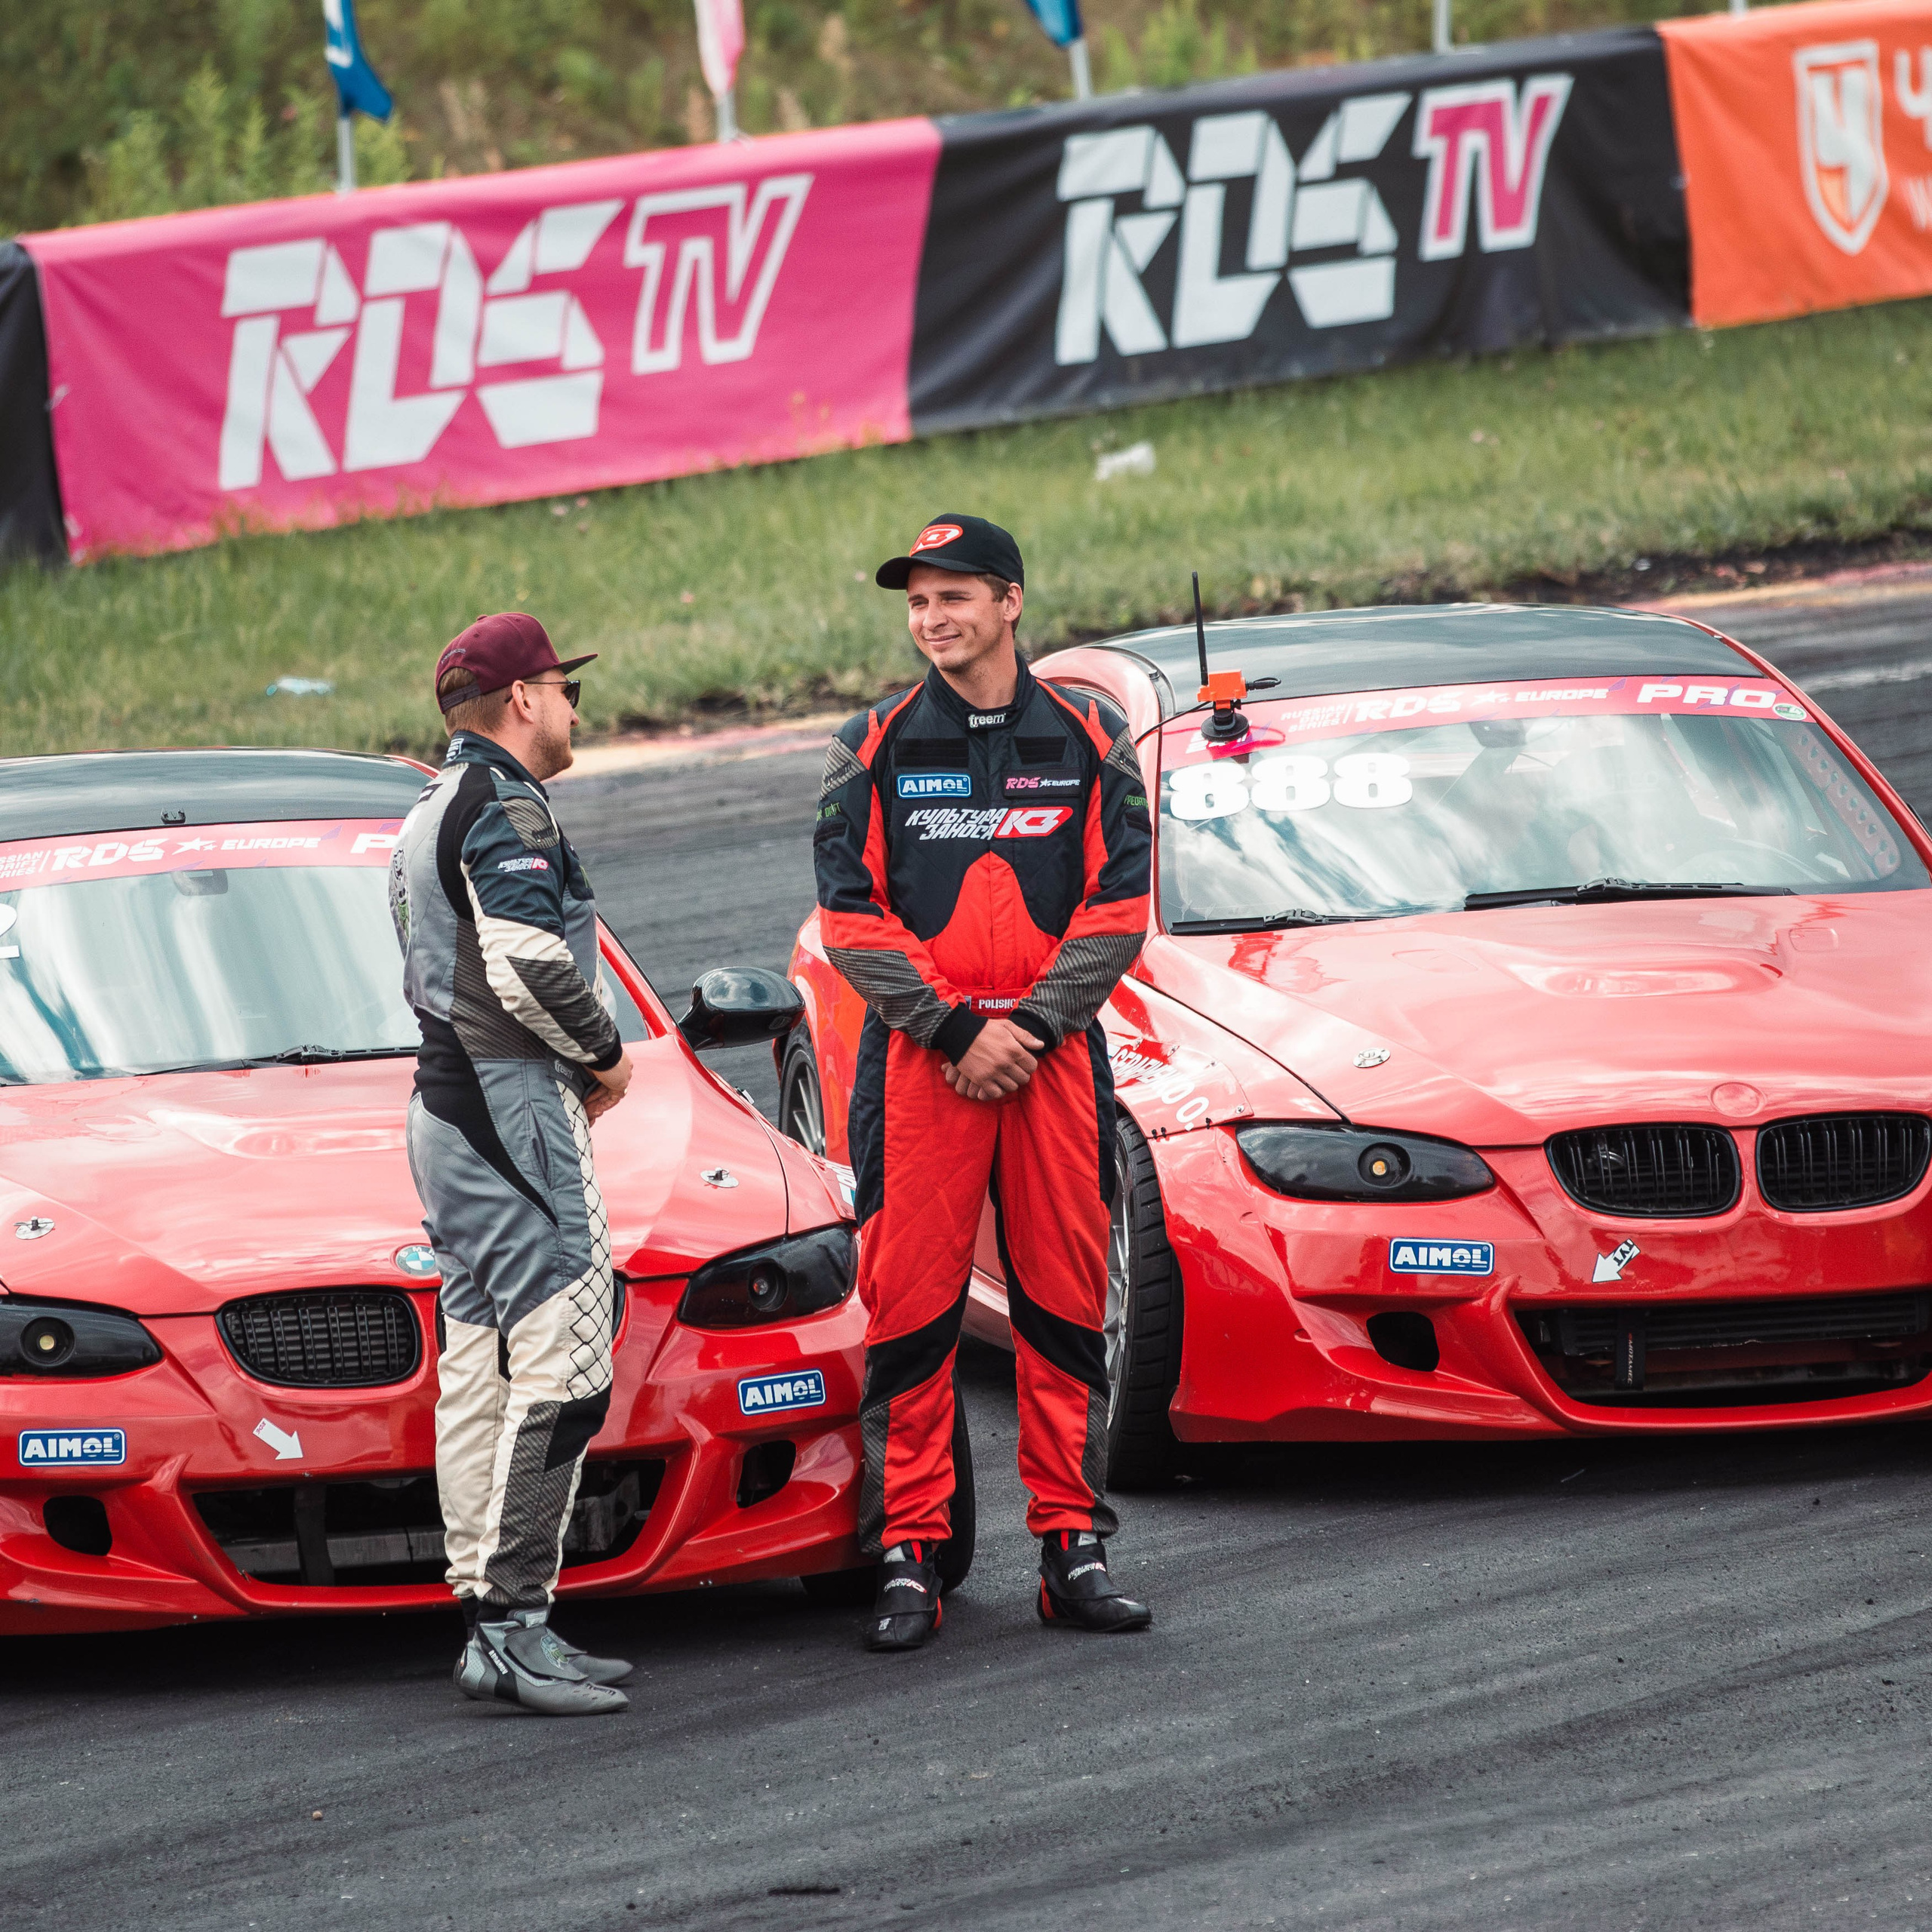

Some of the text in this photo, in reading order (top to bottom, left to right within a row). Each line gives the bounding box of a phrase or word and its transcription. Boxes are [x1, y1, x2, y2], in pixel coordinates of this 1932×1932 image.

[1057, 91, 1413, 365] RDS
[1413, 72, 1575, 262] TV
[219, 174, 816, 492] RDS TV
[1355, 688, 1611, 723] RDS EUROPE
[1636, 683, 1777, 709] PRO
[968, 712, 1006, 728] freem
[1280, 703, 1346, 721] RUSSIAN
[1299, 712, 1343, 725] DRIFT
[1287, 718, 1341, 733] SERIES
[902, 777, 968, 793] AIMOL
[1005, 776, 1081, 790] RDS EUROPE
[1169, 753, 1413, 820] 888
[905, 808, 1009, 827] КУЛЬТУРА
[919, 823, 999, 841] ЗАНОСА
[51, 837, 322, 872] RDS EUROPE
[978, 998, 1018, 1009] POLISHC
[1176, 1097, 1210, 1131] O.
[1394, 1246, 1488, 1268] AIMOL
[745, 1378, 822, 1407] AIMOL
[23, 1437, 120, 1458] AIMOL
